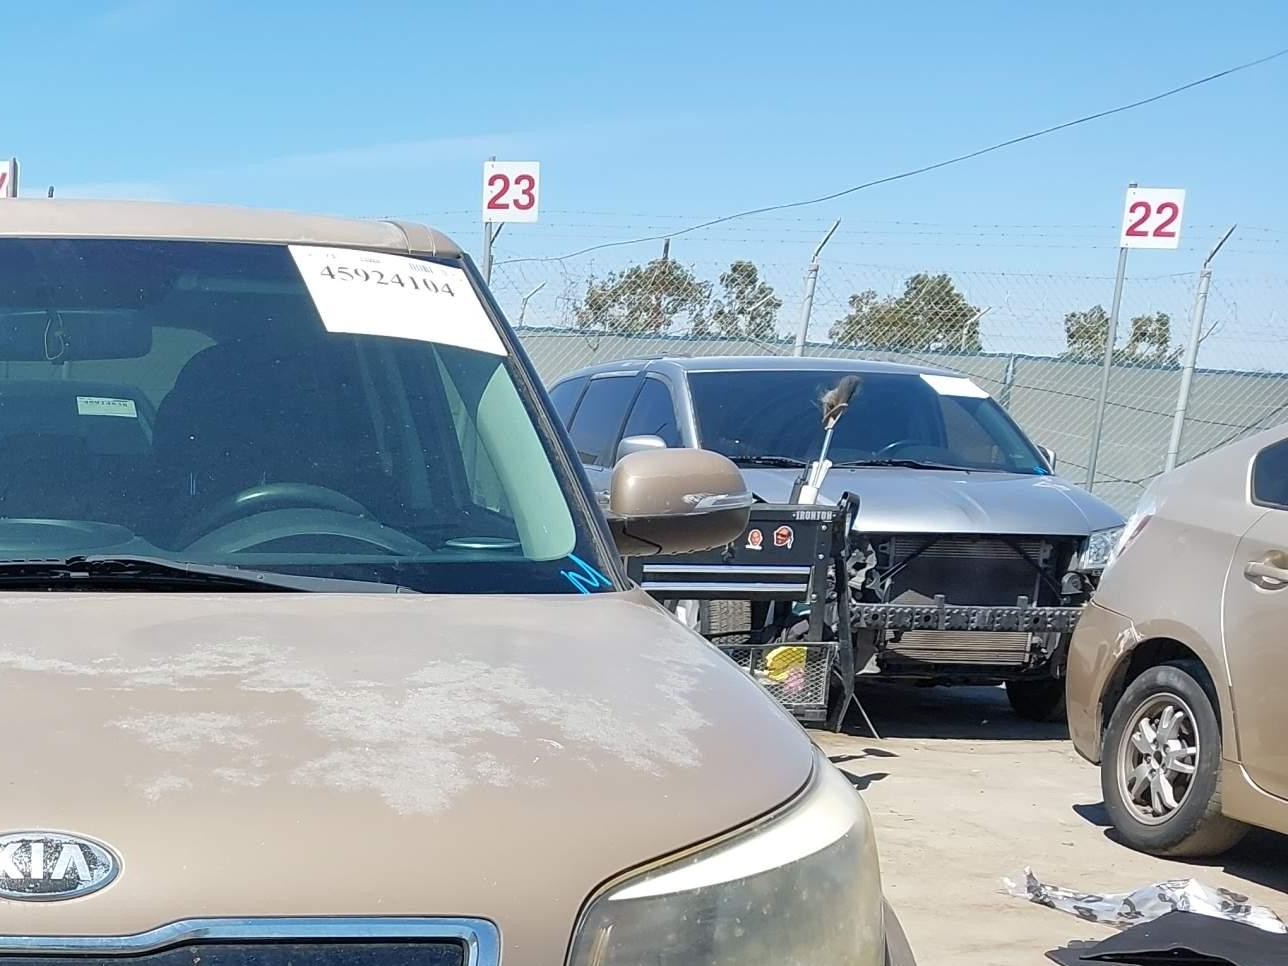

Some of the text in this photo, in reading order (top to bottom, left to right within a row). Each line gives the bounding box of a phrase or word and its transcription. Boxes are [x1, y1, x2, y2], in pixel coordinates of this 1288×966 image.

[487, 174, 535, 210] 23
[1125, 201, 1179, 238] 22
[320, 265, 455, 297] 45924104
